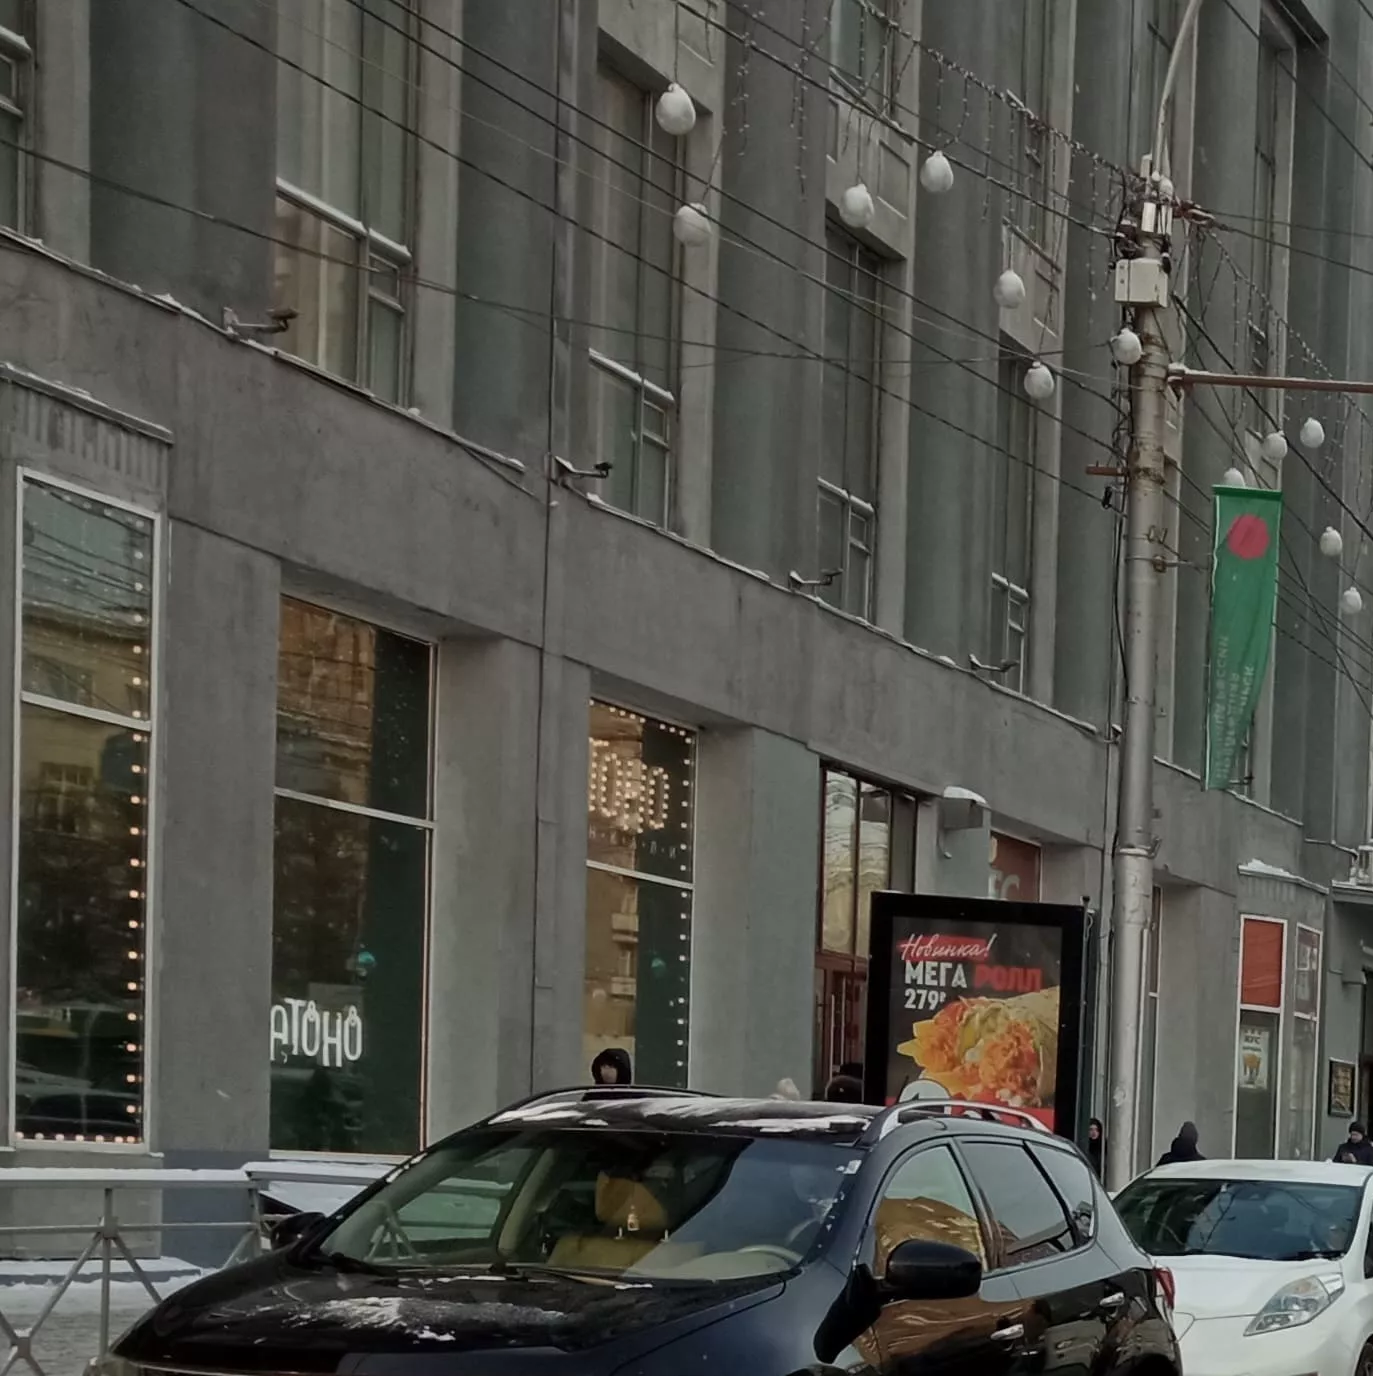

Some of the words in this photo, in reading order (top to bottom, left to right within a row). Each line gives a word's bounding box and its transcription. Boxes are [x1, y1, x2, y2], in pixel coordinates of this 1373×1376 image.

[899, 933, 997, 960] Новинка!
[905, 961, 967, 989] МЕГА
[974, 964, 1042, 993] РОЛЛ
